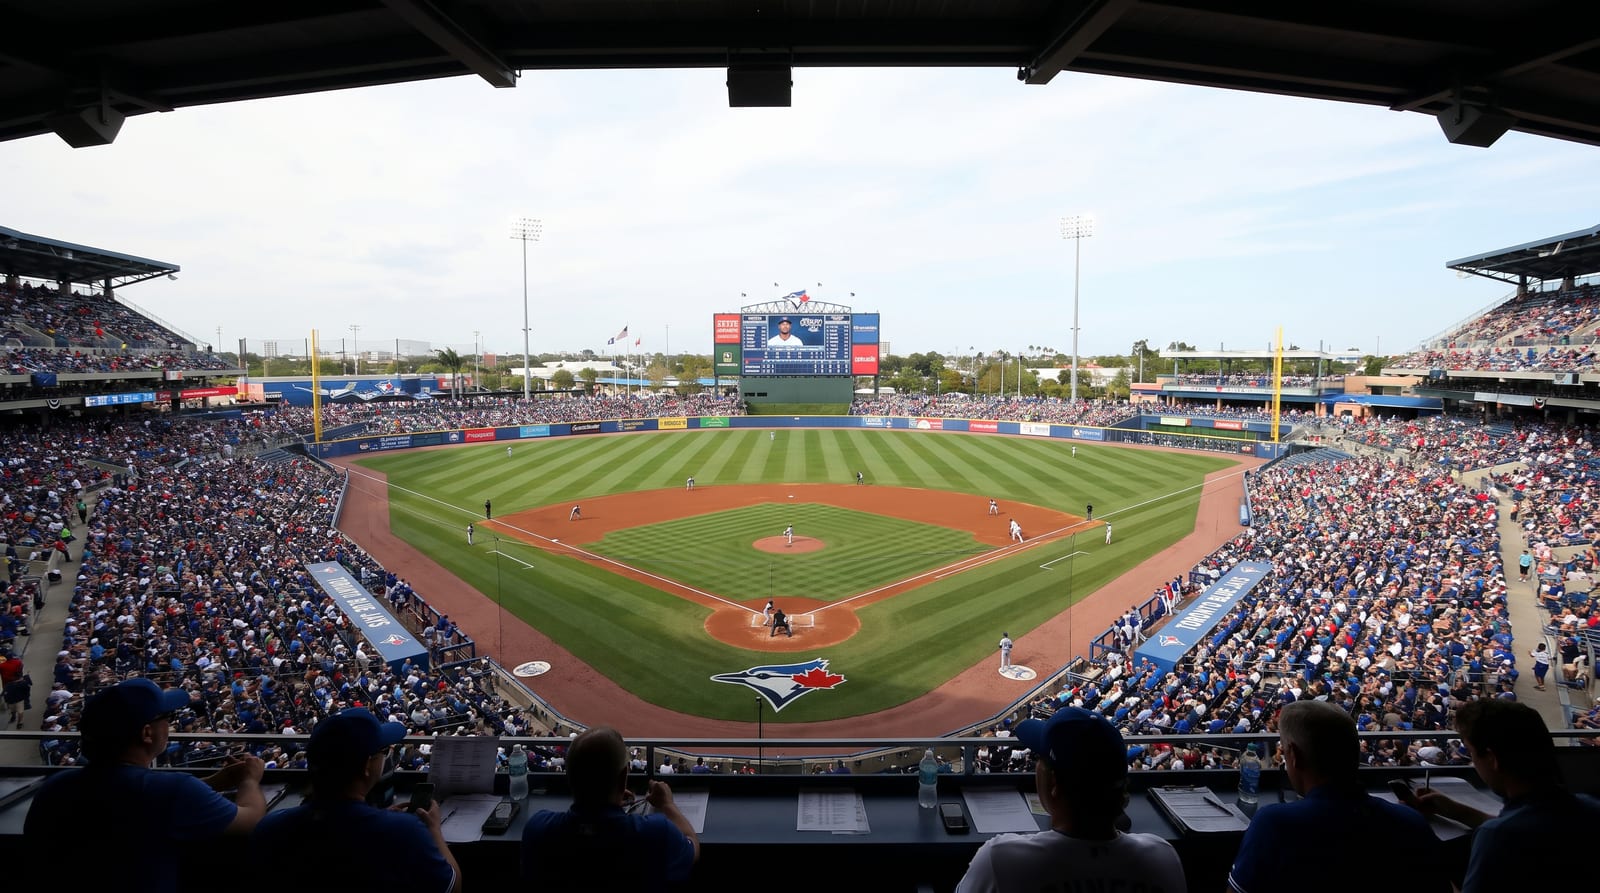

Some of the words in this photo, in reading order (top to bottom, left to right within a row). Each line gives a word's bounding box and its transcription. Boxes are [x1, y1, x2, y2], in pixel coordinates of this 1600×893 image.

[346, 597, 376, 613] BLUE
[1175, 601, 1223, 631] TORONTO
[1207, 587, 1239, 603] BLUE
[360, 612, 391, 628] JAYS
